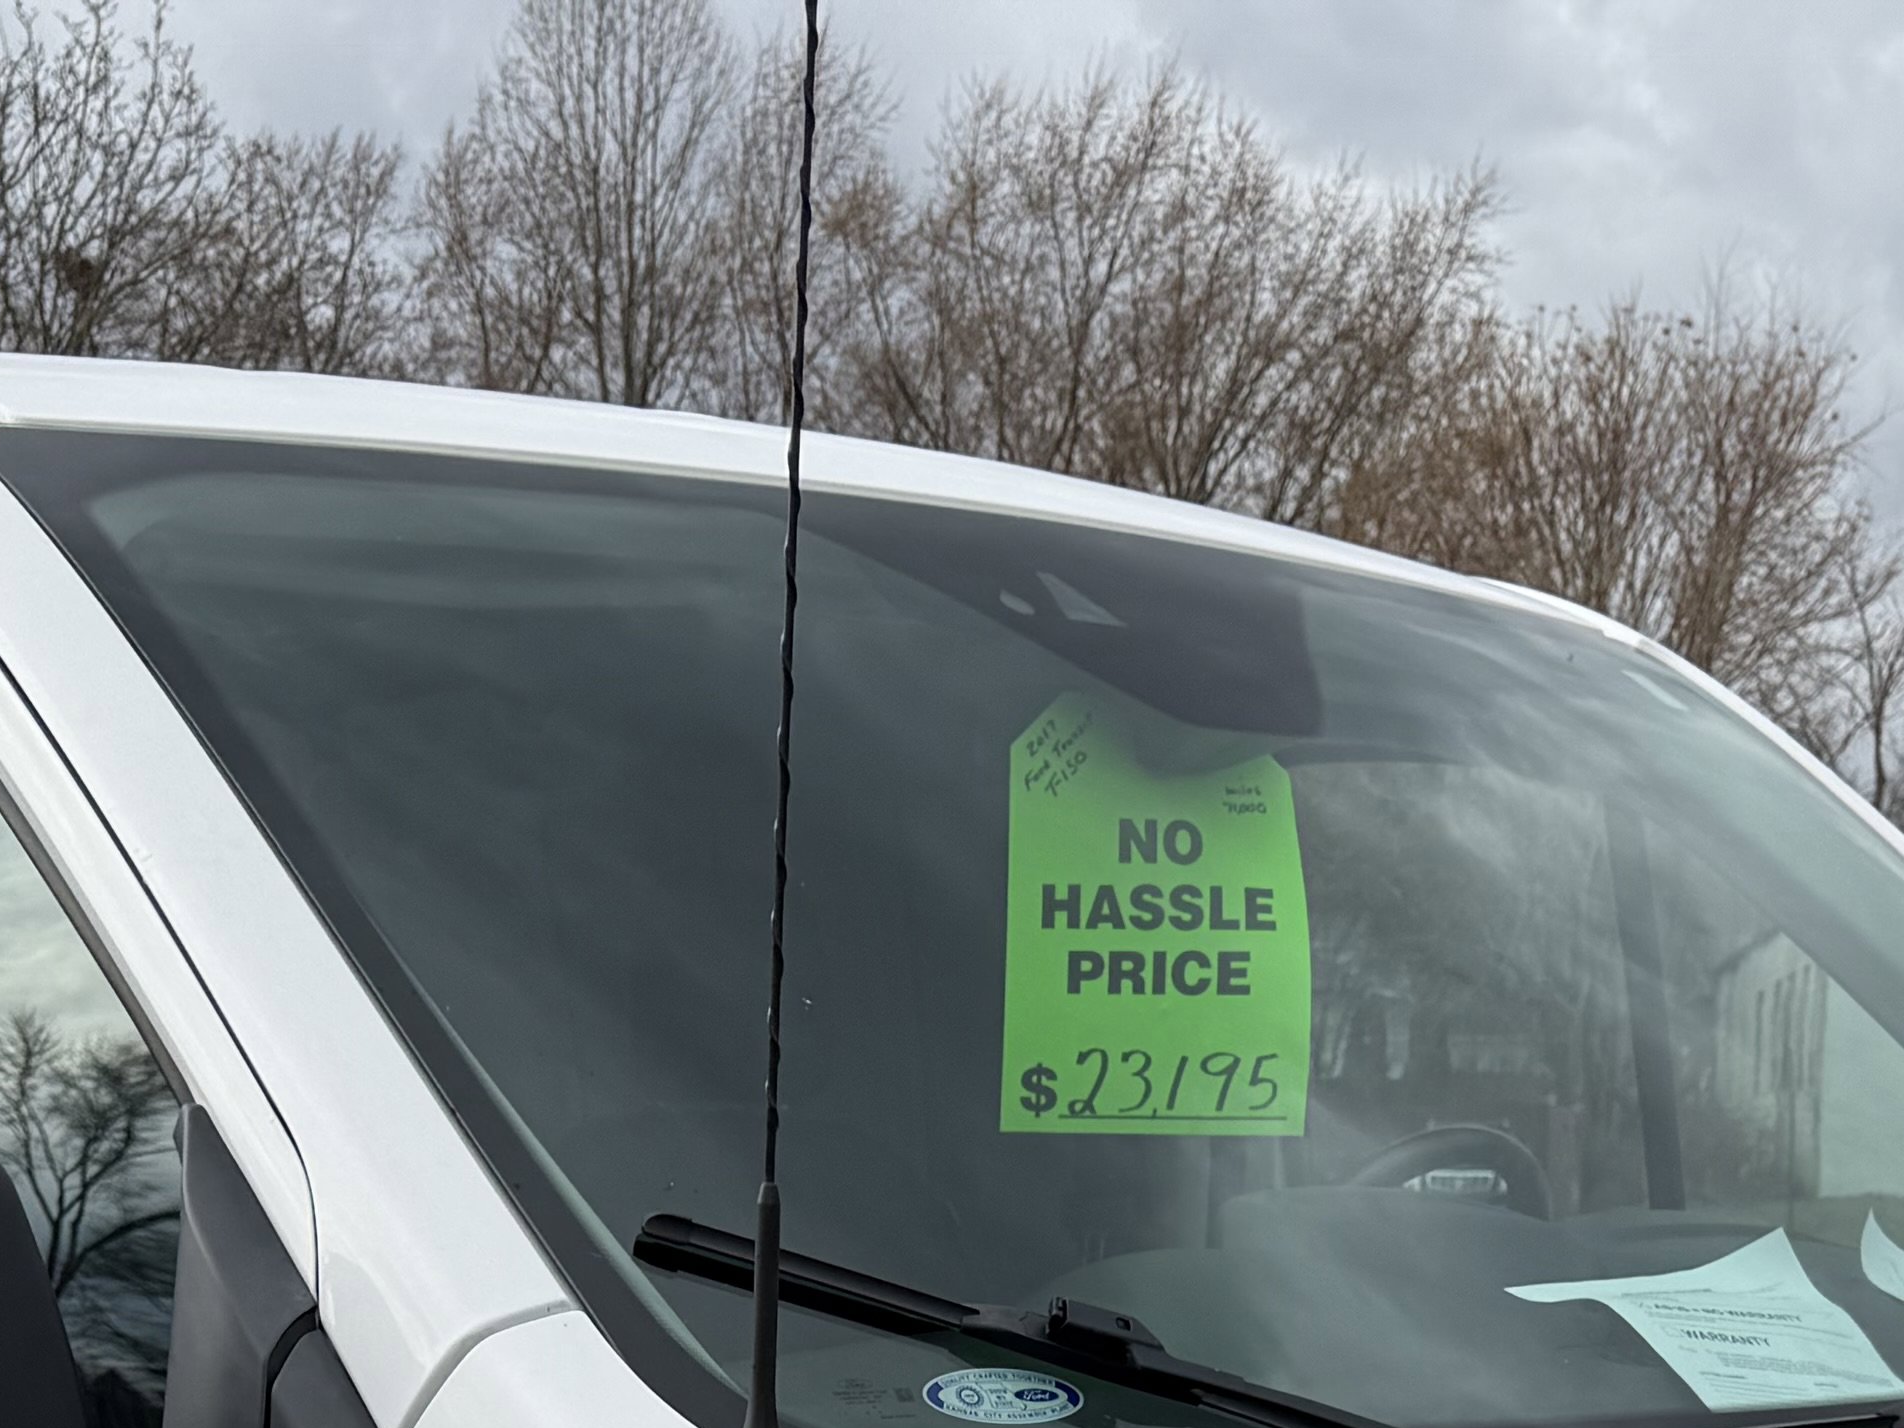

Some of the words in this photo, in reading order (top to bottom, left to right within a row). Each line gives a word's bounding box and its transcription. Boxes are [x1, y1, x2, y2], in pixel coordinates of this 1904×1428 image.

[1025, 719, 1056, 758] 2017
[1043, 750, 1088, 798] T-150
[1117, 818, 1204, 865] NO
[1040, 883, 1278, 932] HASSLE
[1066, 950, 1252, 996] PRICE
[1681, 1327, 1772, 1347] WARRANTY
